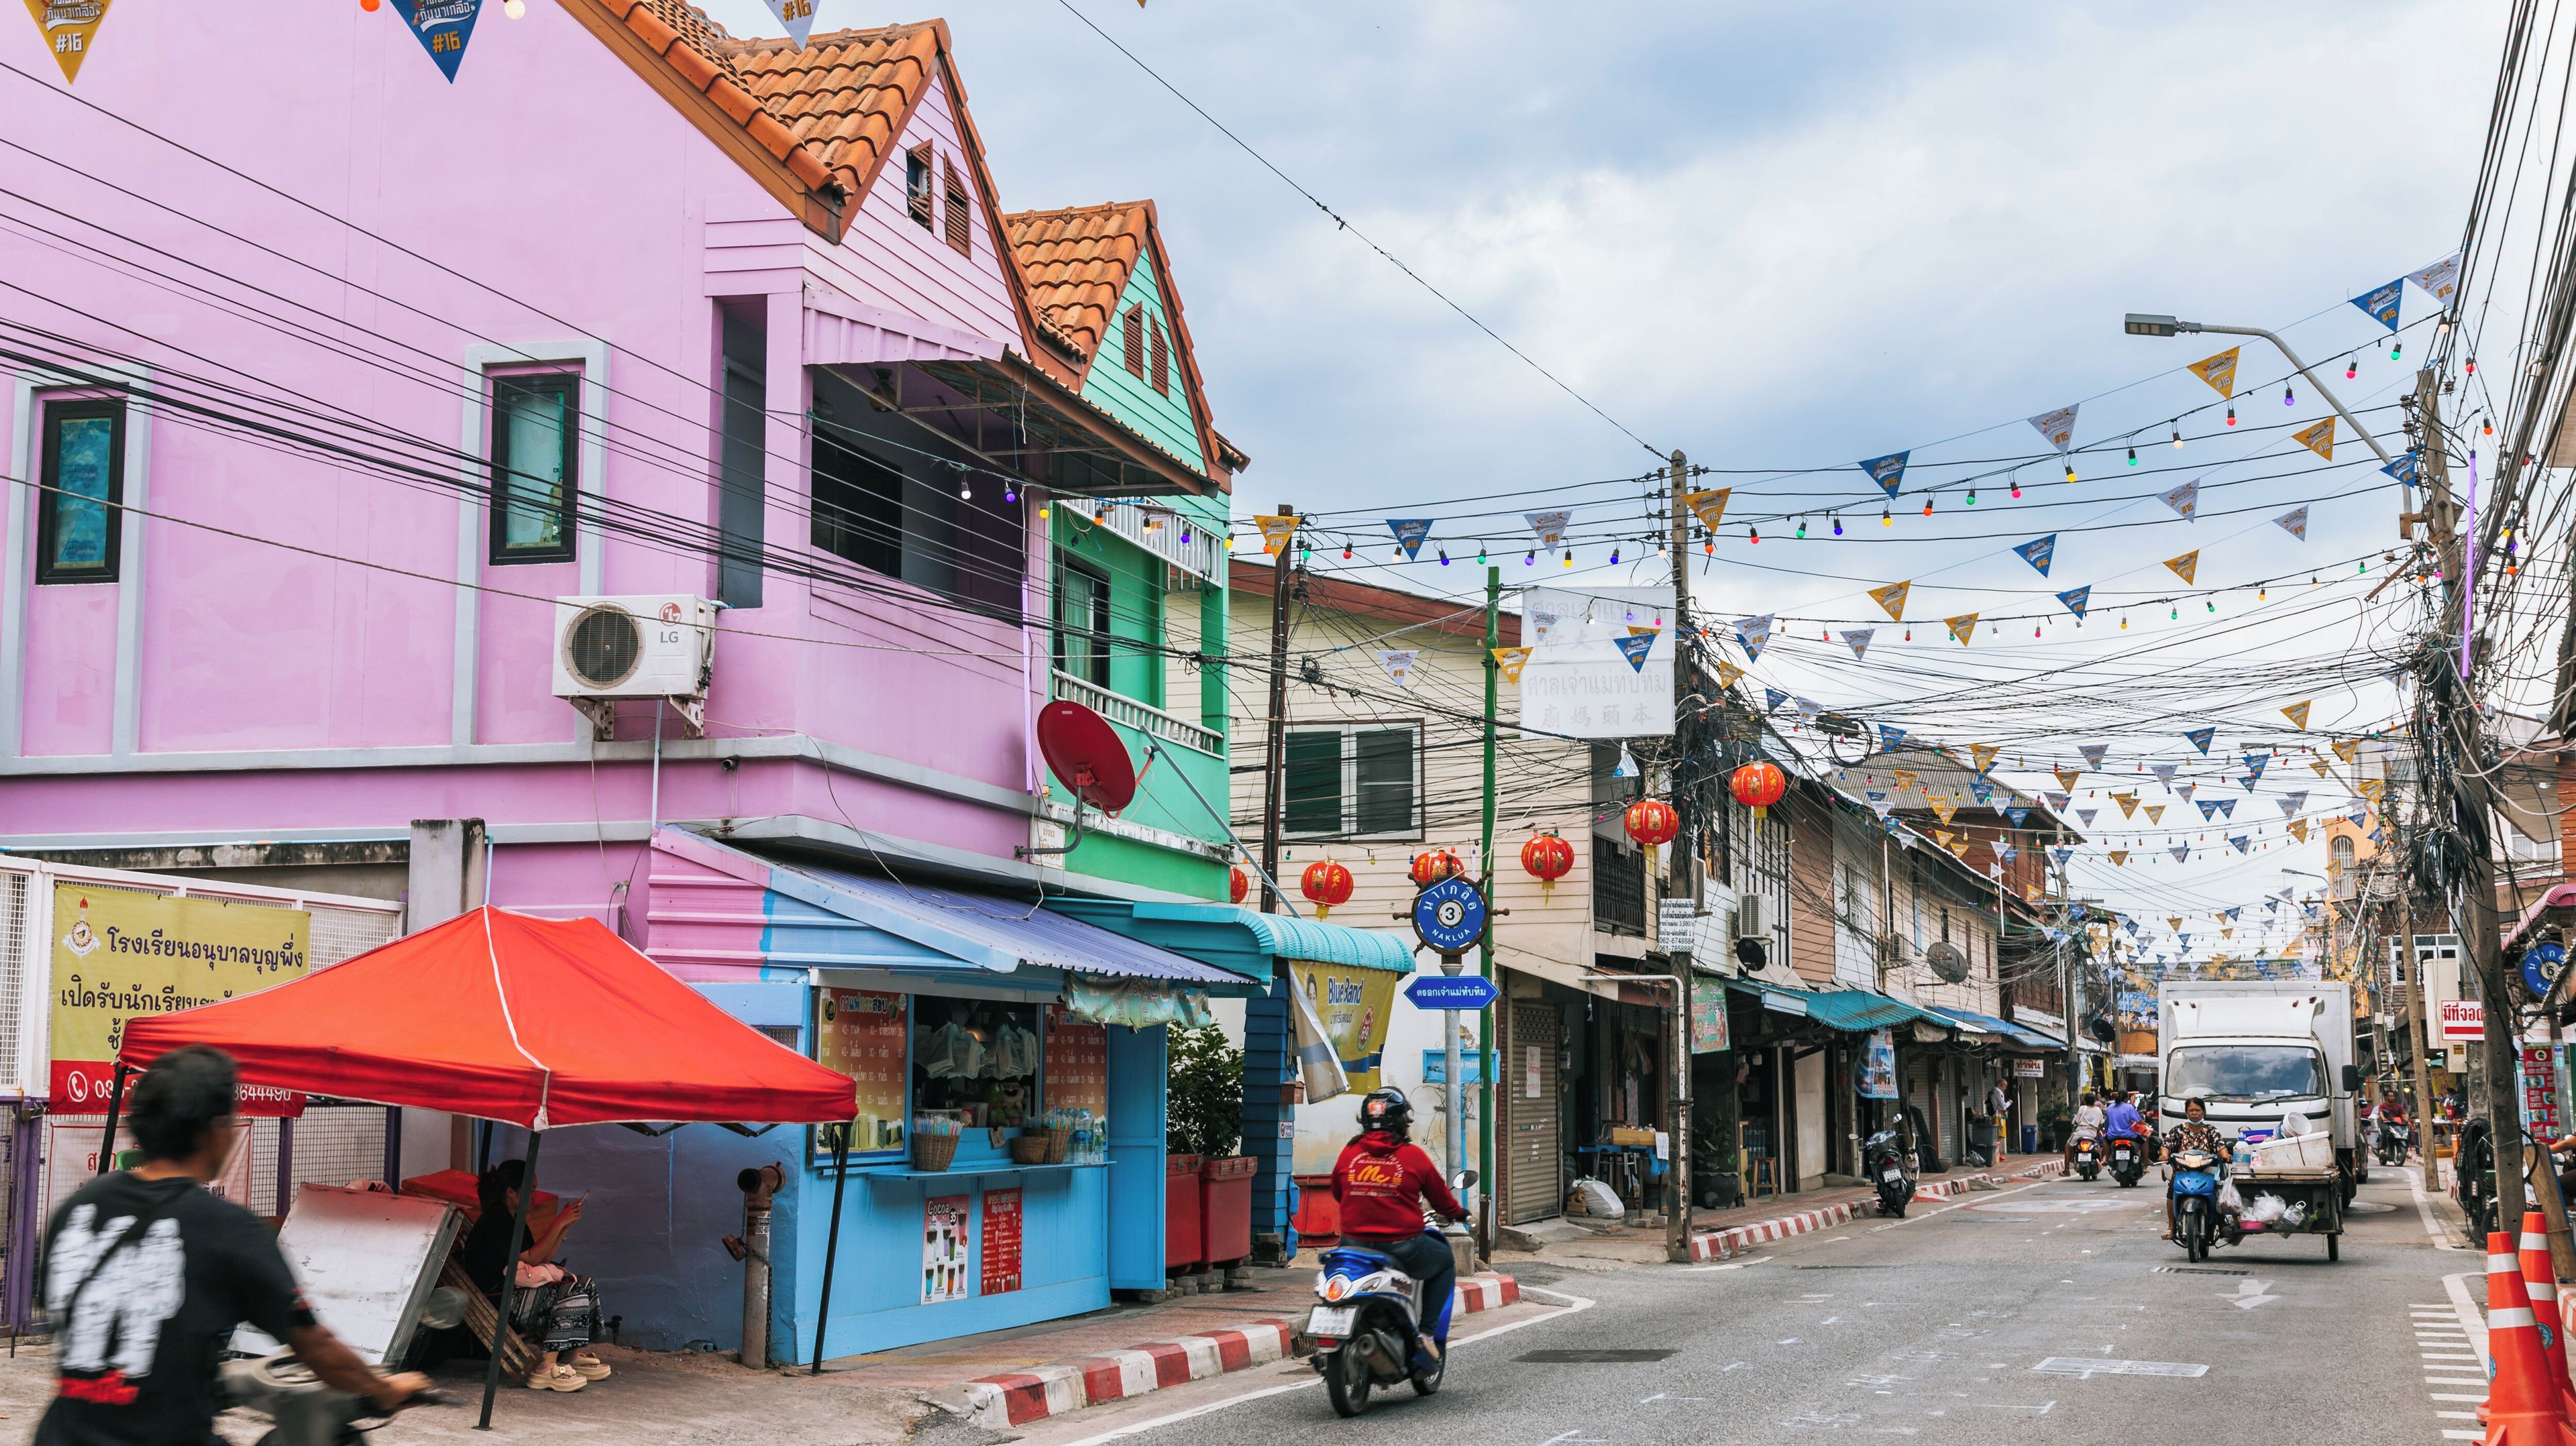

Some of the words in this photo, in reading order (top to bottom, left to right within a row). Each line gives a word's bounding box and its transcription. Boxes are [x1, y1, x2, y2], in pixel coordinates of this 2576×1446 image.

[782, 0, 812, 21] #16
[56, 32, 83, 52] #16
[433, 30, 462, 54] #16
[2438, 284, 2453, 298] #16
[2382, 307, 2396, 321] #16
[2216, 376, 2231, 389] #16
[2054, 431, 2069, 445] #16
[2318, 441, 2330, 453] #16
[1884, 476, 1897, 488] #16
[2182, 503, 2194, 514] #16
[1705, 512, 1718, 522] #16
[1271, 539, 1283, 547] #16
[1545, 533, 1558, 543] #16
[1406, 541, 1418, 549] #16
[2036, 558, 2049, 569] #16
[1890, 603, 1901, 612] #16
[660, 631, 678, 643] LG
[1752, 635, 1764, 645] #16
[1632, 655, 1643, 663] #16
[1527, 666, 1666, 696] ศาลเจ้าแม่ทับทิม
[1424, 885, 1477, 911] นาเกลือ
[1445, 907, 1455, 921] 3
[1432, 929, 1470, 941] NAKLUA
[1328, 977, 1344, 1005] Blue
[1344, 977, 1364, 1005] Band
[1417, 986, 1487, 997] ตรอกเจ้าแม่ทับทิม
[1357, 1165, 1391, 1182] Mc
[928, 1200, 949, 1215] Cocoa
[950, 1211, 957, 1223] 35
